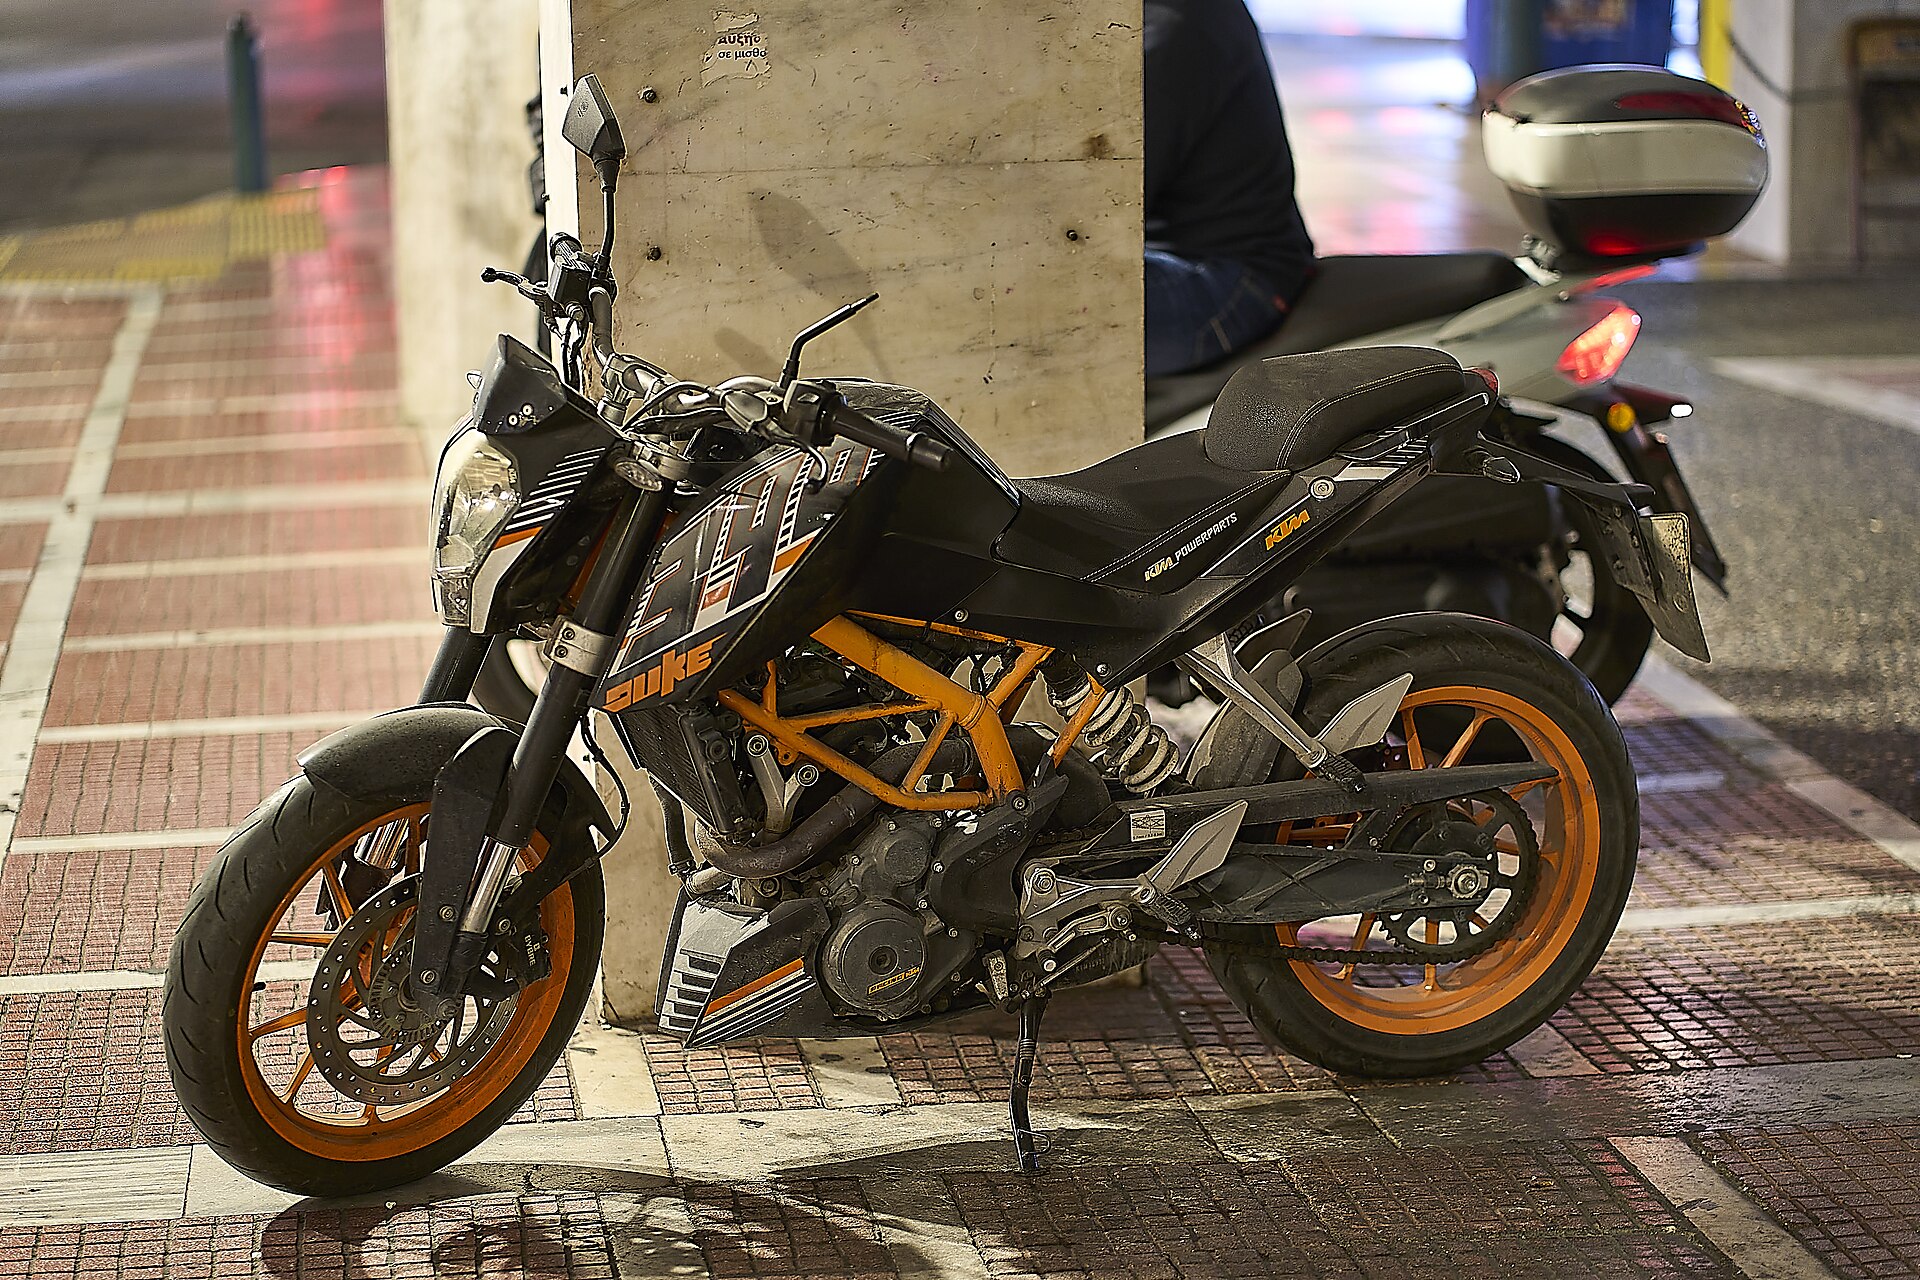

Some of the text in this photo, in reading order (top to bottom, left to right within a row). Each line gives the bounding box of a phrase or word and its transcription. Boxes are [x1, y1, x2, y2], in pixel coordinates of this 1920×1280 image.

[718, 50, 732, 59] σε
[1144, 513, 1238, 582] KTM POWERPARTS
[1265, 509, 1311, 551] KTM
[524, 934, 537, 967] BYBRE
